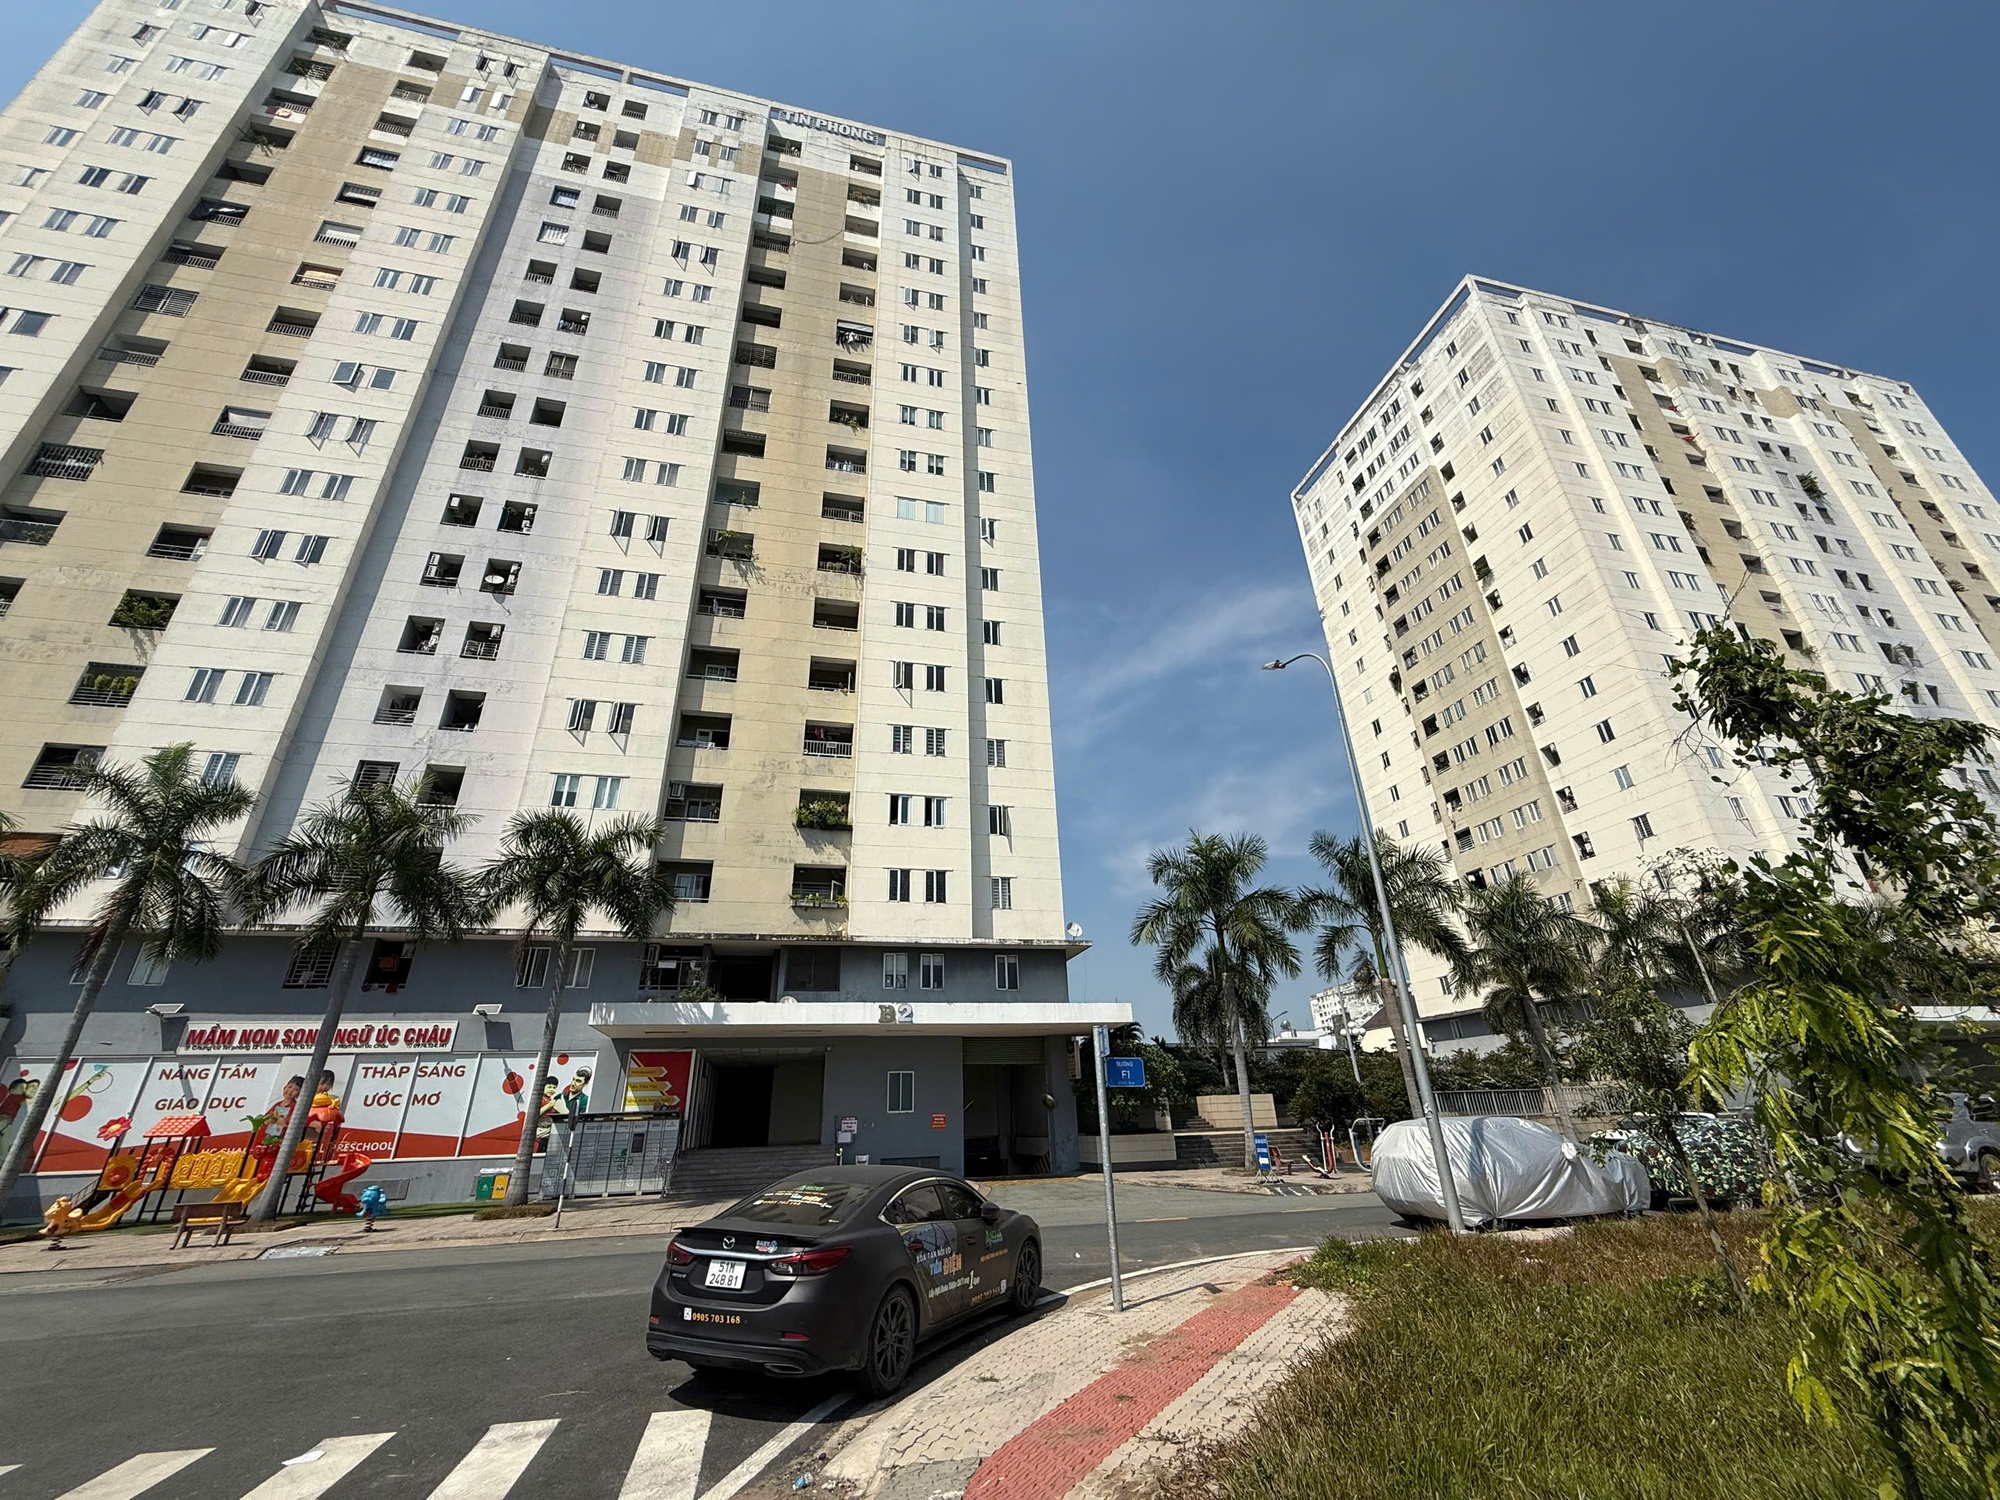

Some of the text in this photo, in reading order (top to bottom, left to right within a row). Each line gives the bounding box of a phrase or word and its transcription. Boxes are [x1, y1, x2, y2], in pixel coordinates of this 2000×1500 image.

[816, 118, 875, 141] PHONG
[879, 1003, 914, 1023] B2
[185, 1023, 237, 1045] MẦM
[238, 1029, 280, 1045] NON
[333, 1024, 375, 1044] NGỮ
[375, 1025, 401, 1046] ÚC
[403, 1024, 453, 1045] CHÂU
[158, 1064, 211, 1080] NÂNG
[362, 1061, 466, 1079] THẮP SÁNG
[1121, 1070, 1130, 1079] F1
[155, 1093, 247, 1112] GIÁO DỤC
[363, 1090, 442, 1107] ƯỚC MƠ
[709, 1273, 738, 1286] 248.81
[692, 1312, 741, 1324] 0905 703 168
